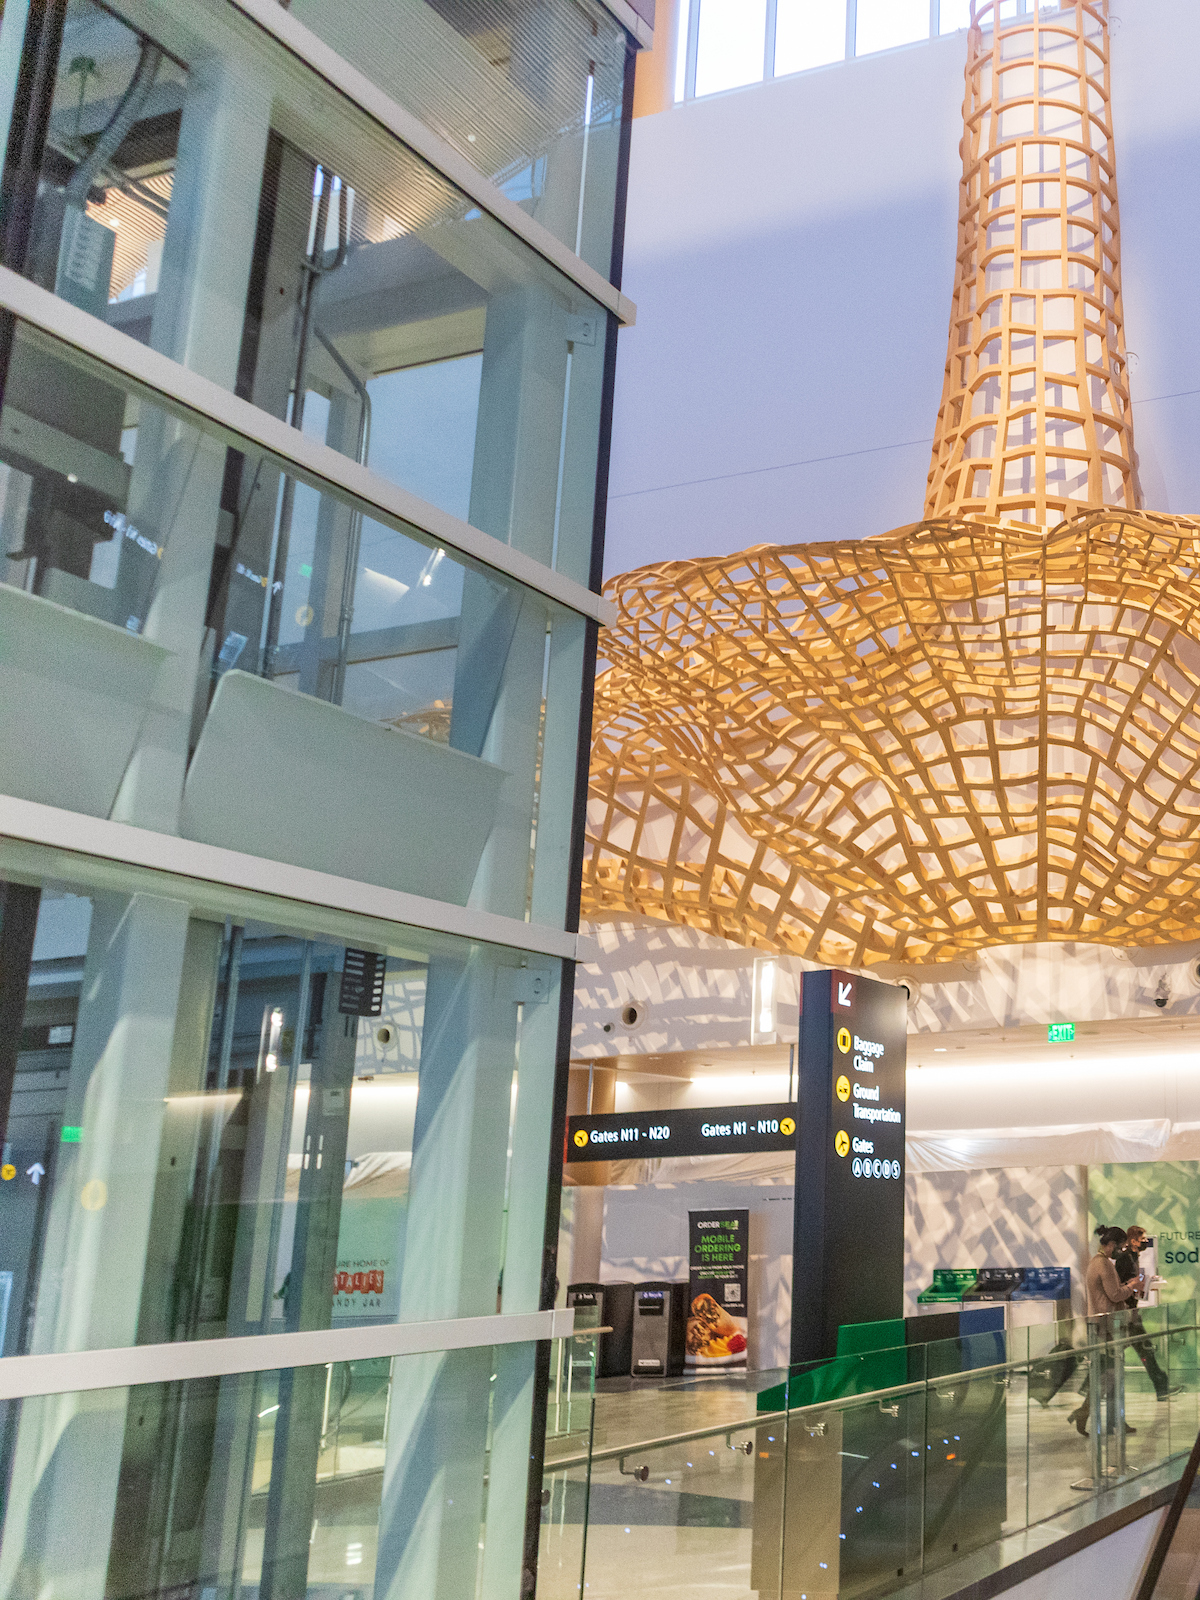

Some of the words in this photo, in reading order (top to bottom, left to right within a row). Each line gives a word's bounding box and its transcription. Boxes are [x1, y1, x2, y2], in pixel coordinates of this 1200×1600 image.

[1052, 1025, 1072, 1040] EXIT
[853, 1035, 885, 1058] Baggage
[853, 1055, 874, 1073] Claim
[853, 1082, 880, 1101] Ground
[852, 1102, 901, 1124] Transportation
[590, 1129, 619, 1144] Gates
[620, 1127, 639, 1142] N11
[649, 1126, 670, 1140] N20
[701, 1122, 731, 1137] Gates
[733, 1121, 747, 1135] N1
[757, 1119, 779, 1134] N10
[852, 1136, 874, 1154] Gates
[701, 1234, 735, 1244] MOBILE
[1160, 1230, 1200, 1240] FUTURE
[694, 1243, 741, 1253] ORDERING
[702, 1253, 710, 1262] IS
[711, 1252, 734, 1262] HERE
